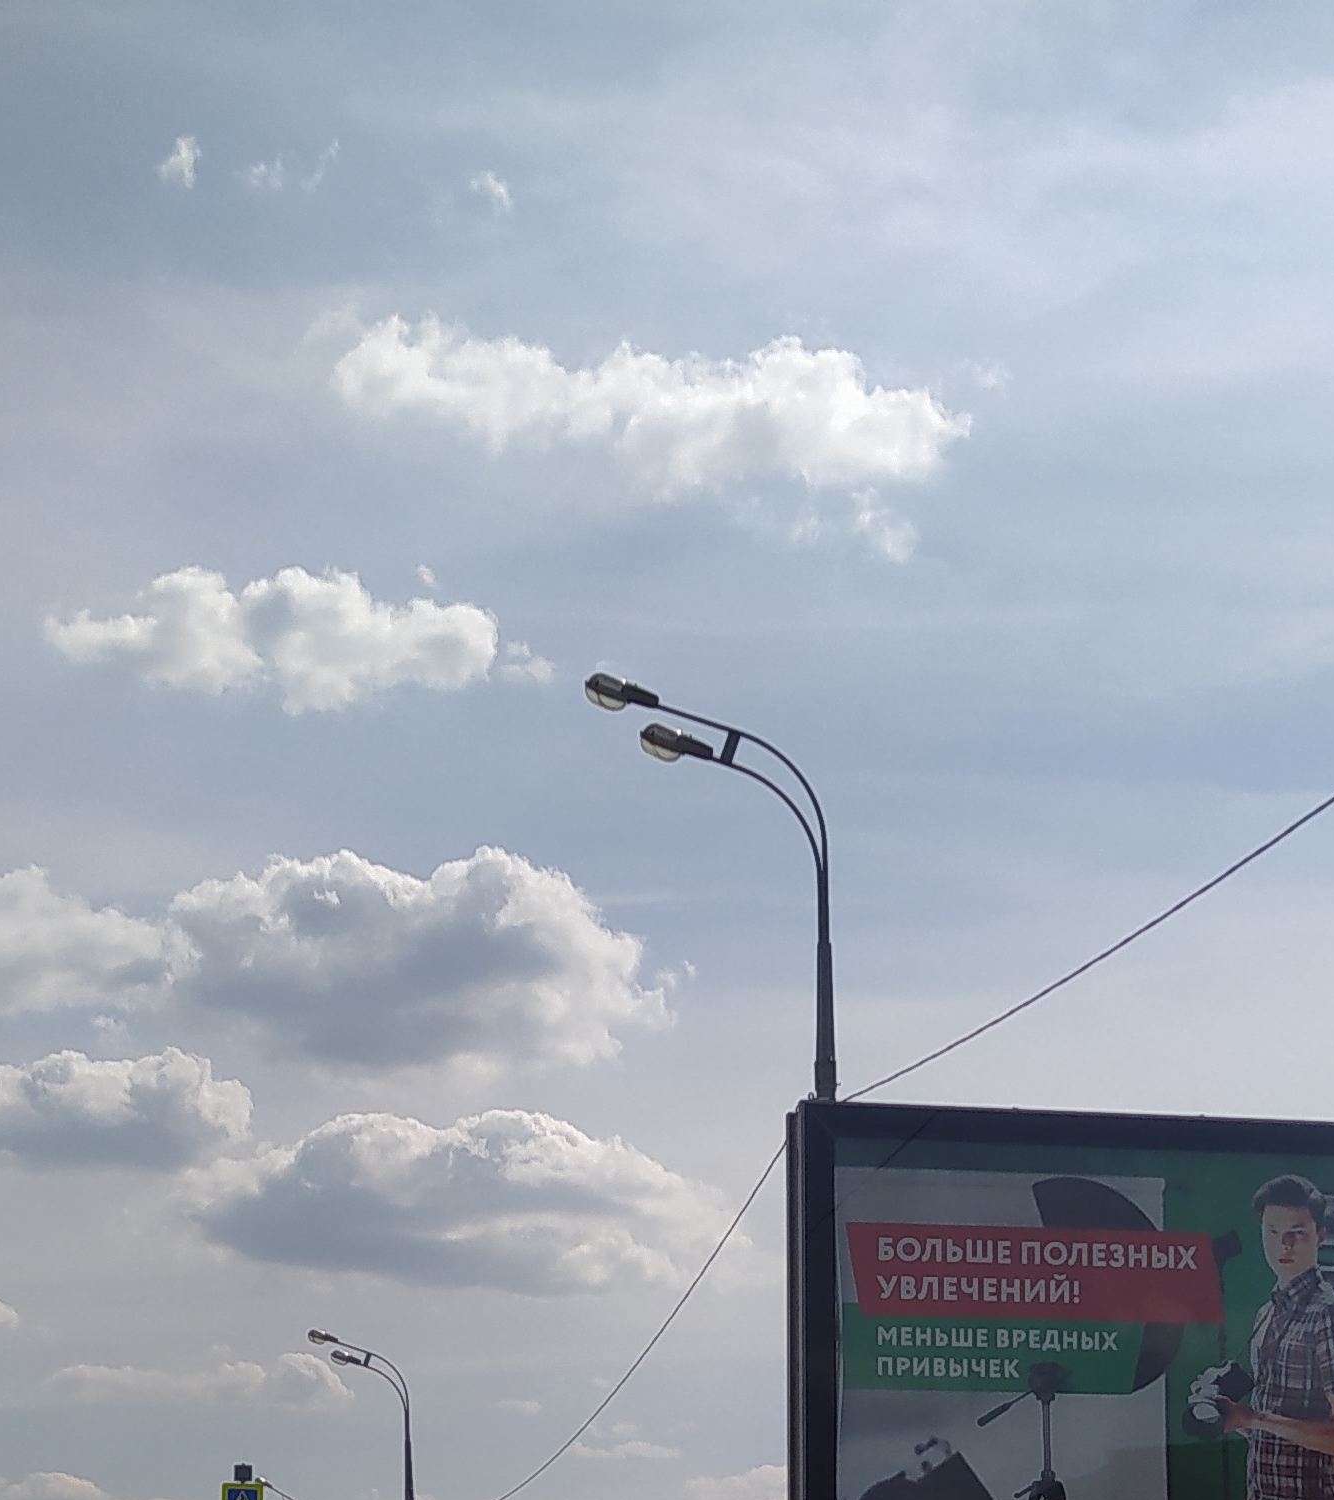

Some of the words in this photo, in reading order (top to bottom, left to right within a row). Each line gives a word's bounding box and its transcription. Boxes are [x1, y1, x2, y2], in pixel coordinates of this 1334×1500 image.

[877, 1236, 1012, 1265] БОЛЬШЕ
[1020, 1240, 1198, 1271] ПОЛЕЗНЫХ
[876, 1273, 1081, 1304] УВЛЕЧЕНИЙ!
[876, 1325, 989, 1348] МЕНЬШЕ
[996, 1329, 1118, 1352] ВРЕДНЫХ
[876, 1356, 1021, 1379] ПРИВЫЧЕК
